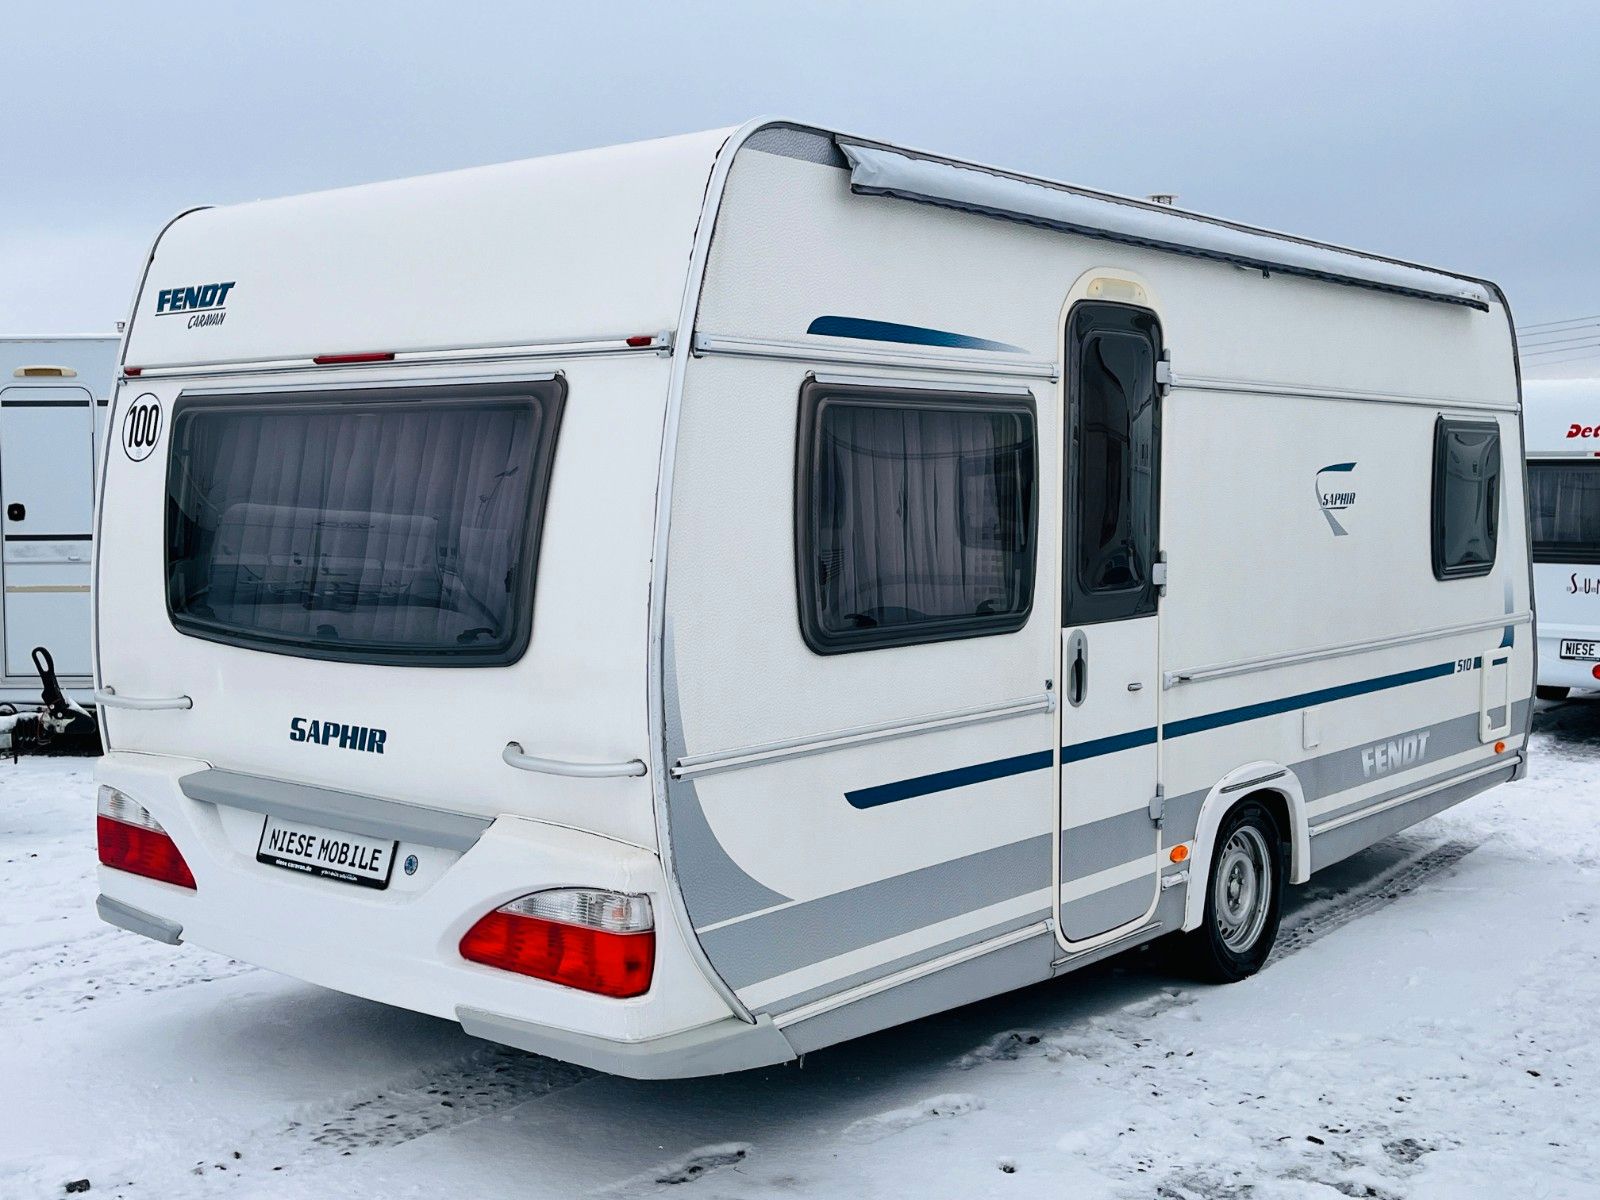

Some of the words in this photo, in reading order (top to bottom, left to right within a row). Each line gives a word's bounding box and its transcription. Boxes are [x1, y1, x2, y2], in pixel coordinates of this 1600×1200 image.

[156, 281, 236, 313] FENDT
[187, 312, 226, 329] CARAVAN
[128, 404, 160, 448] 100
[1322, 492, 1356, 506] SAPHIR
[1565, 642, 1595, 656] NIESE
[1457, 658, 1472, 673] 510
[289, 717, 387, 754] SAPHIR
[1361, 730, 1431, 778] FENDT
[268, 828, 316, 858] NIESE
[317, 838, 382, 872] MOBILE
